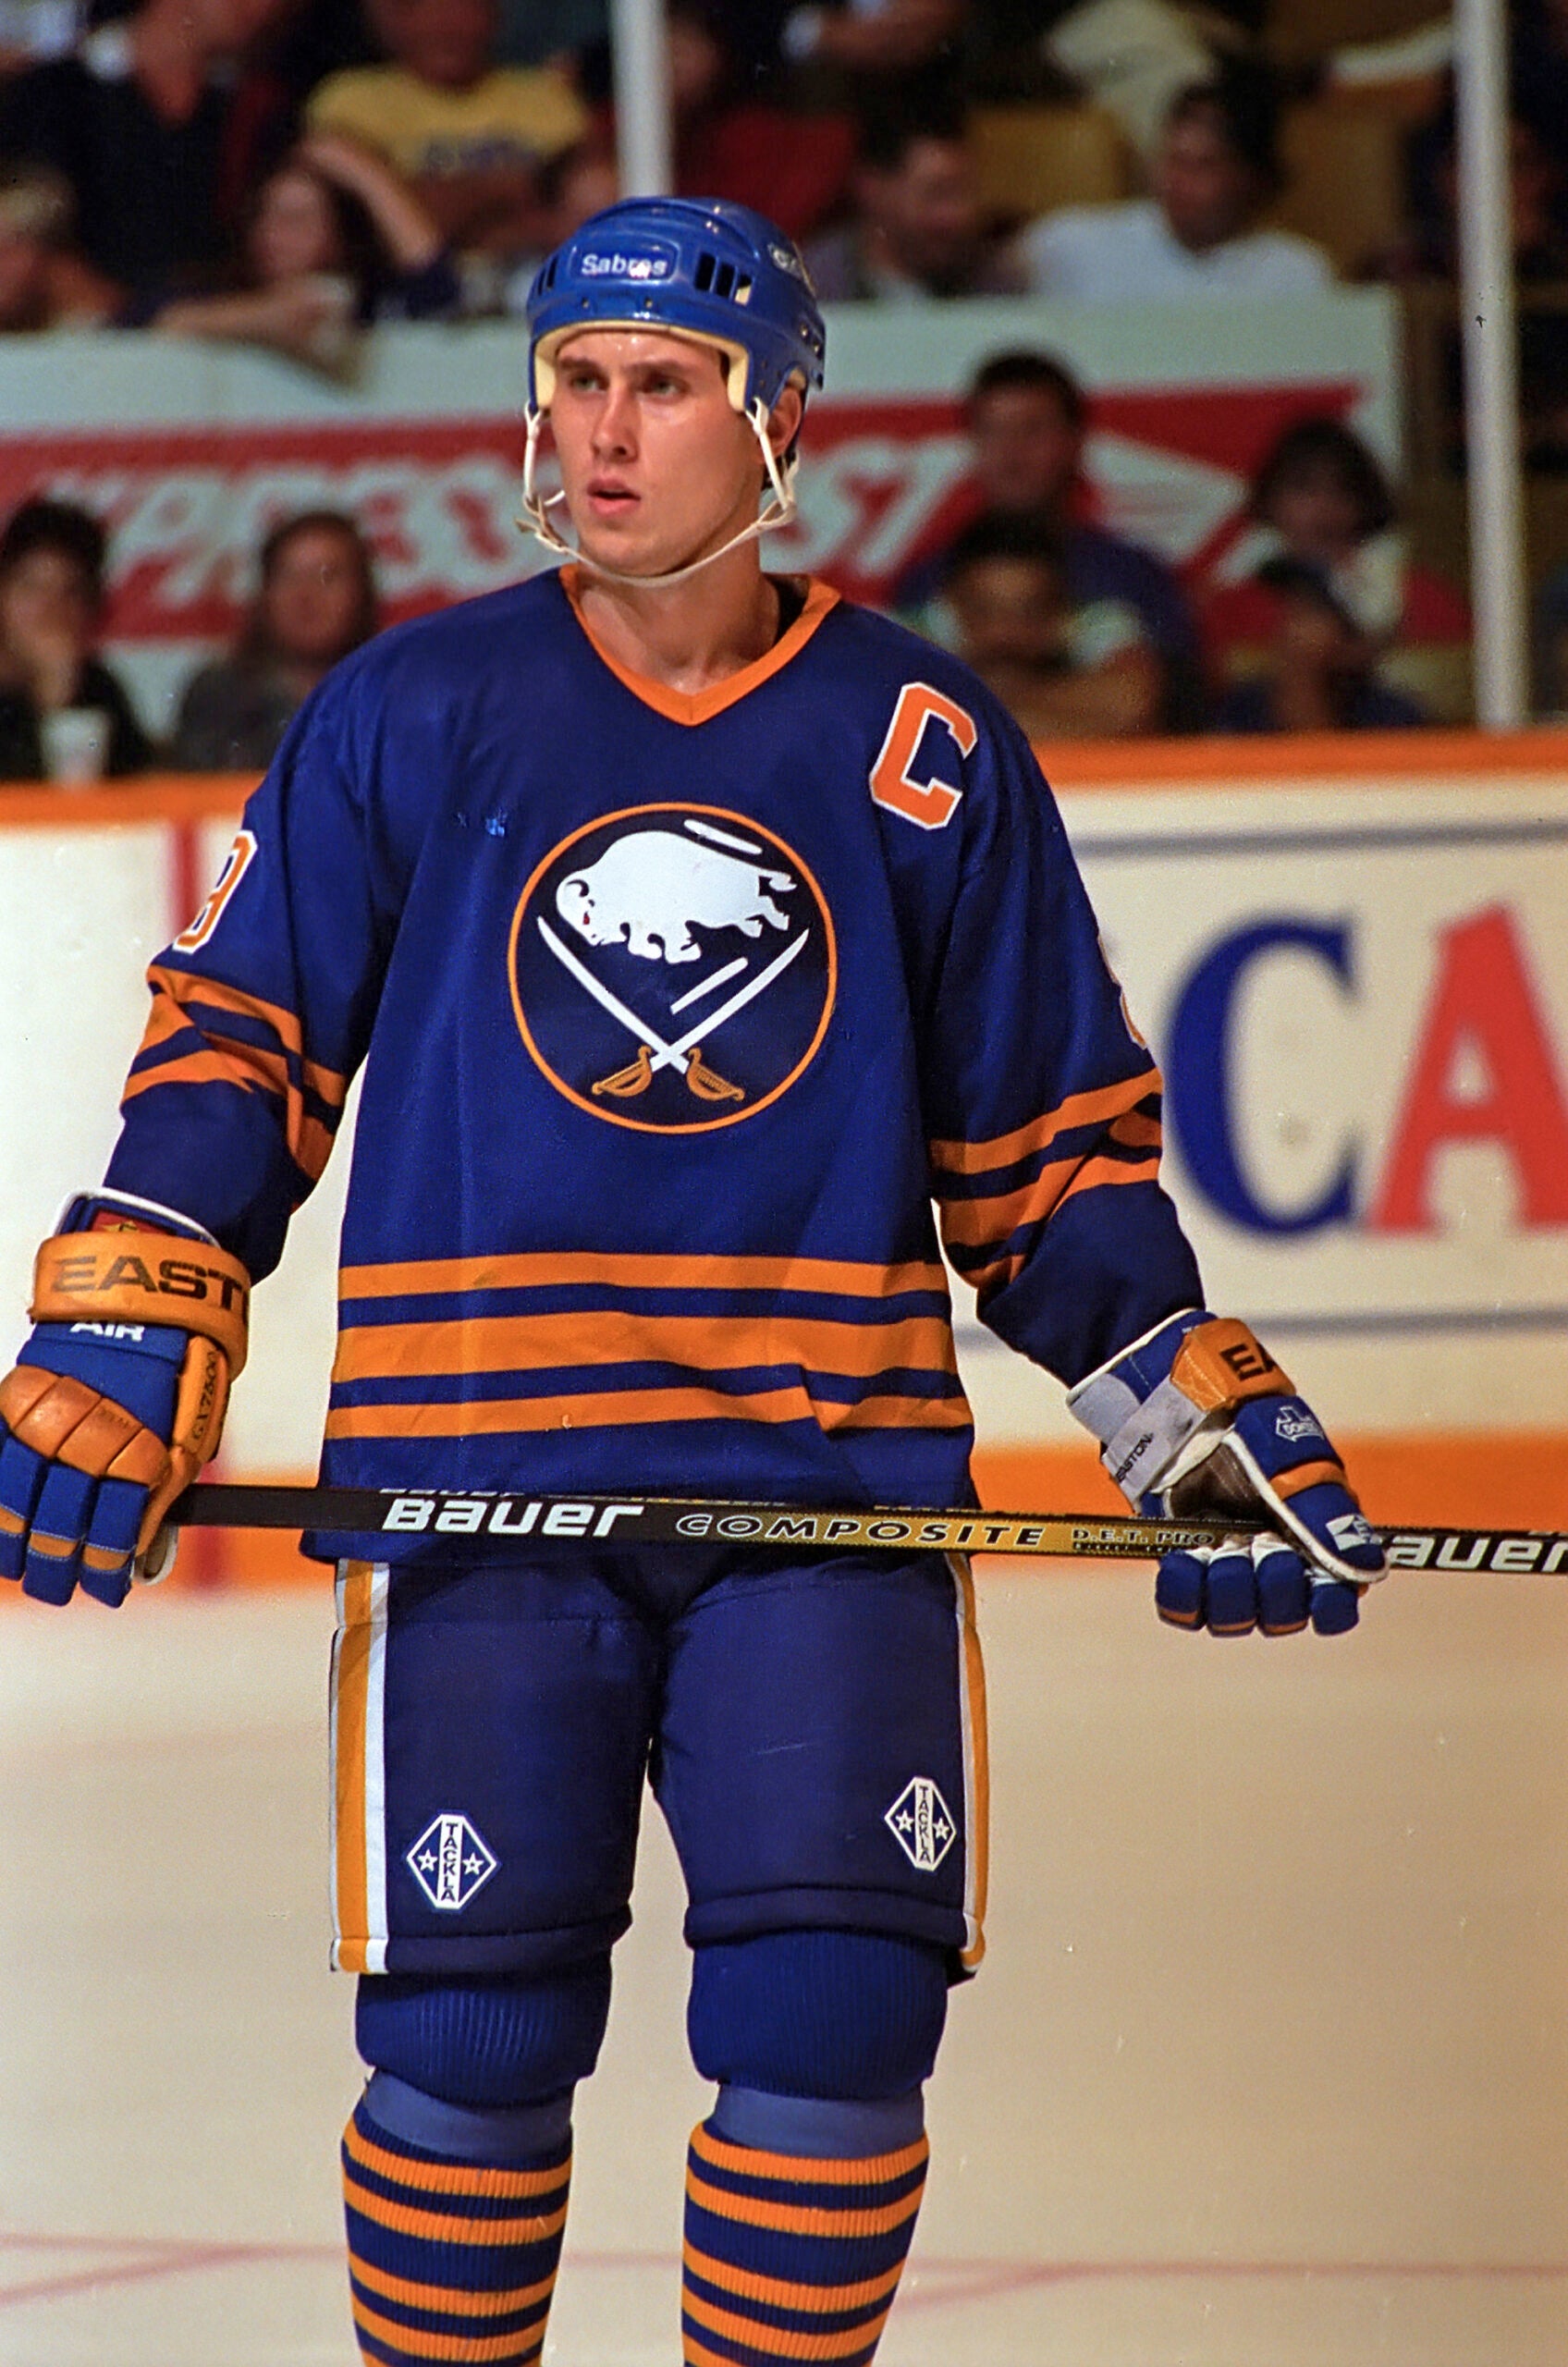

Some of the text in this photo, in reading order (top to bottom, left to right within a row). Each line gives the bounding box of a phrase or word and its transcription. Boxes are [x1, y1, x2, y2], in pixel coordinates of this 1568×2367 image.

[868, 681, 978, 829] C
[1163, 899, 1568, 1245] CA
[51, 1255, 249, 1315] EAST
[69, 1321, 145, 1341] AIR
[382, 1497, 644, 1538] Bauer
[676, 1514, 1045, 1547] COMPOSITE
[1072, 1527, 1148, 1543] D.E.T.
[1389, 1535, 1568, 1573] auer
[913, 1784, 933, 1864] TACKLA
[440, 1821, 459, 1903] TACKLA
